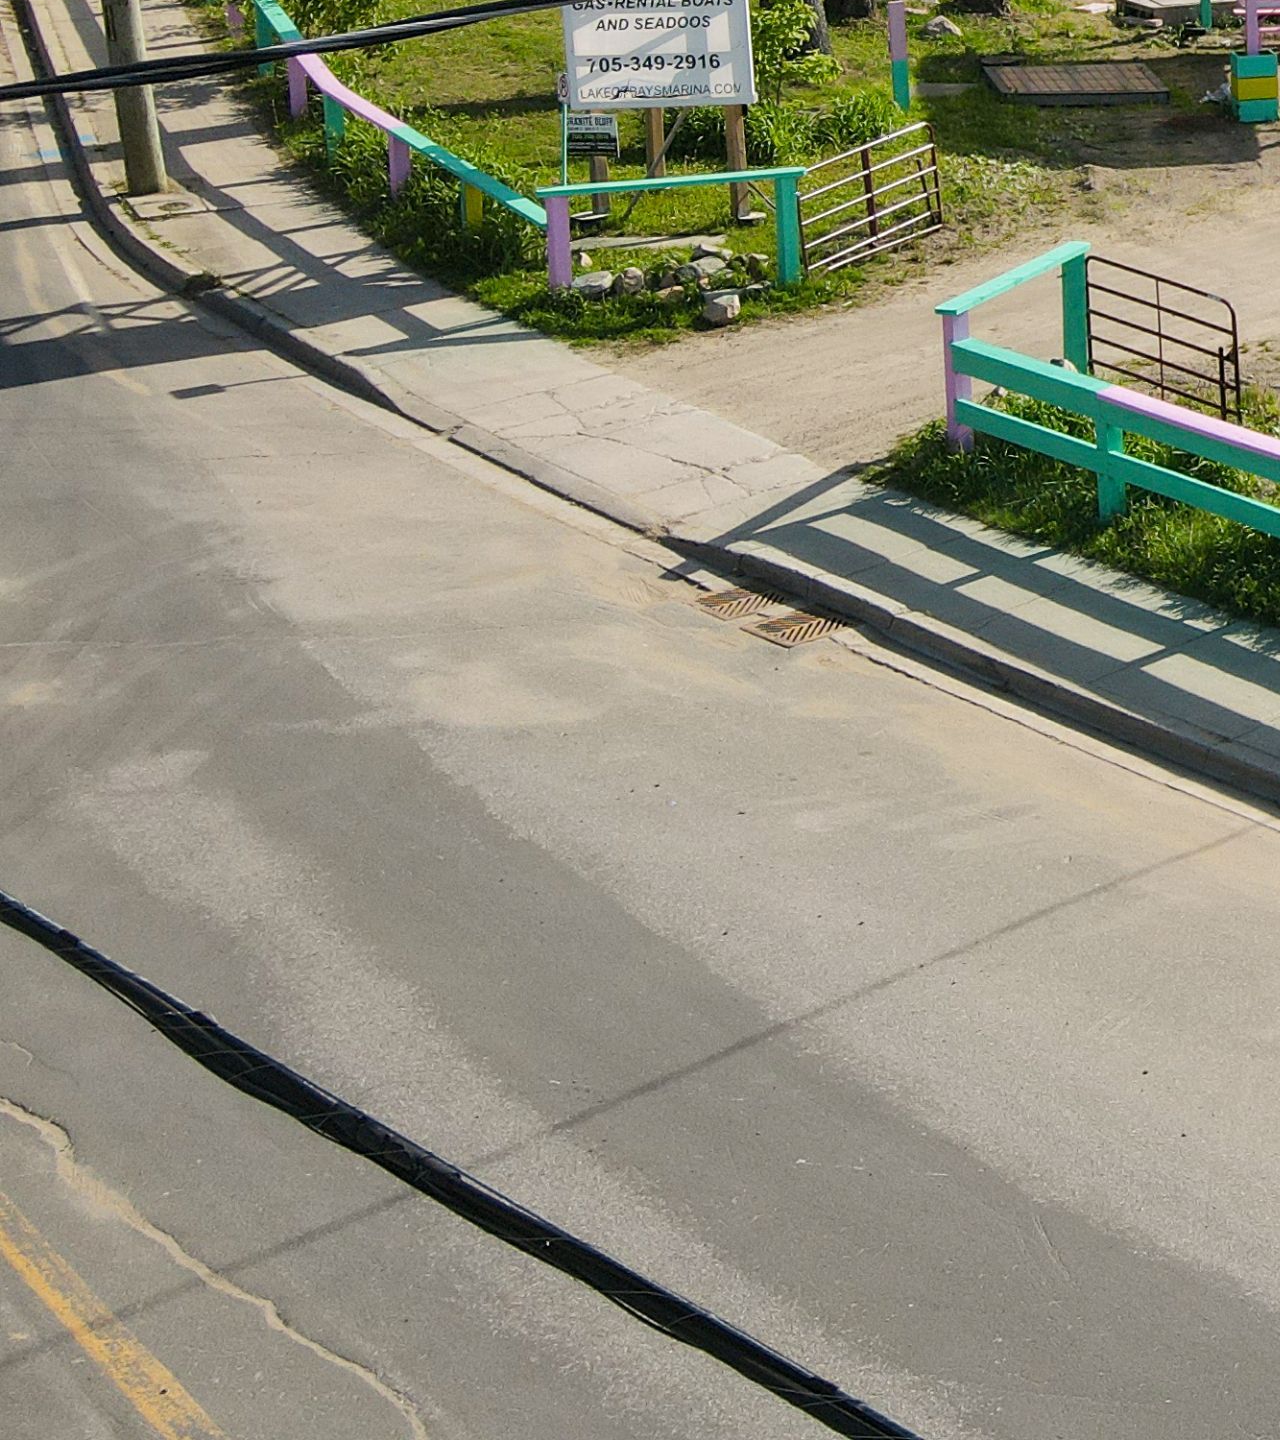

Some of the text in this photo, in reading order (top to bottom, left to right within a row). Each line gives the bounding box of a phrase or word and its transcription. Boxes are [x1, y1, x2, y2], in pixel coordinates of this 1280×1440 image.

[595, 15, 711, 32] AND SEADOOS
[586, 54, 721, 74] 705-349-2916
